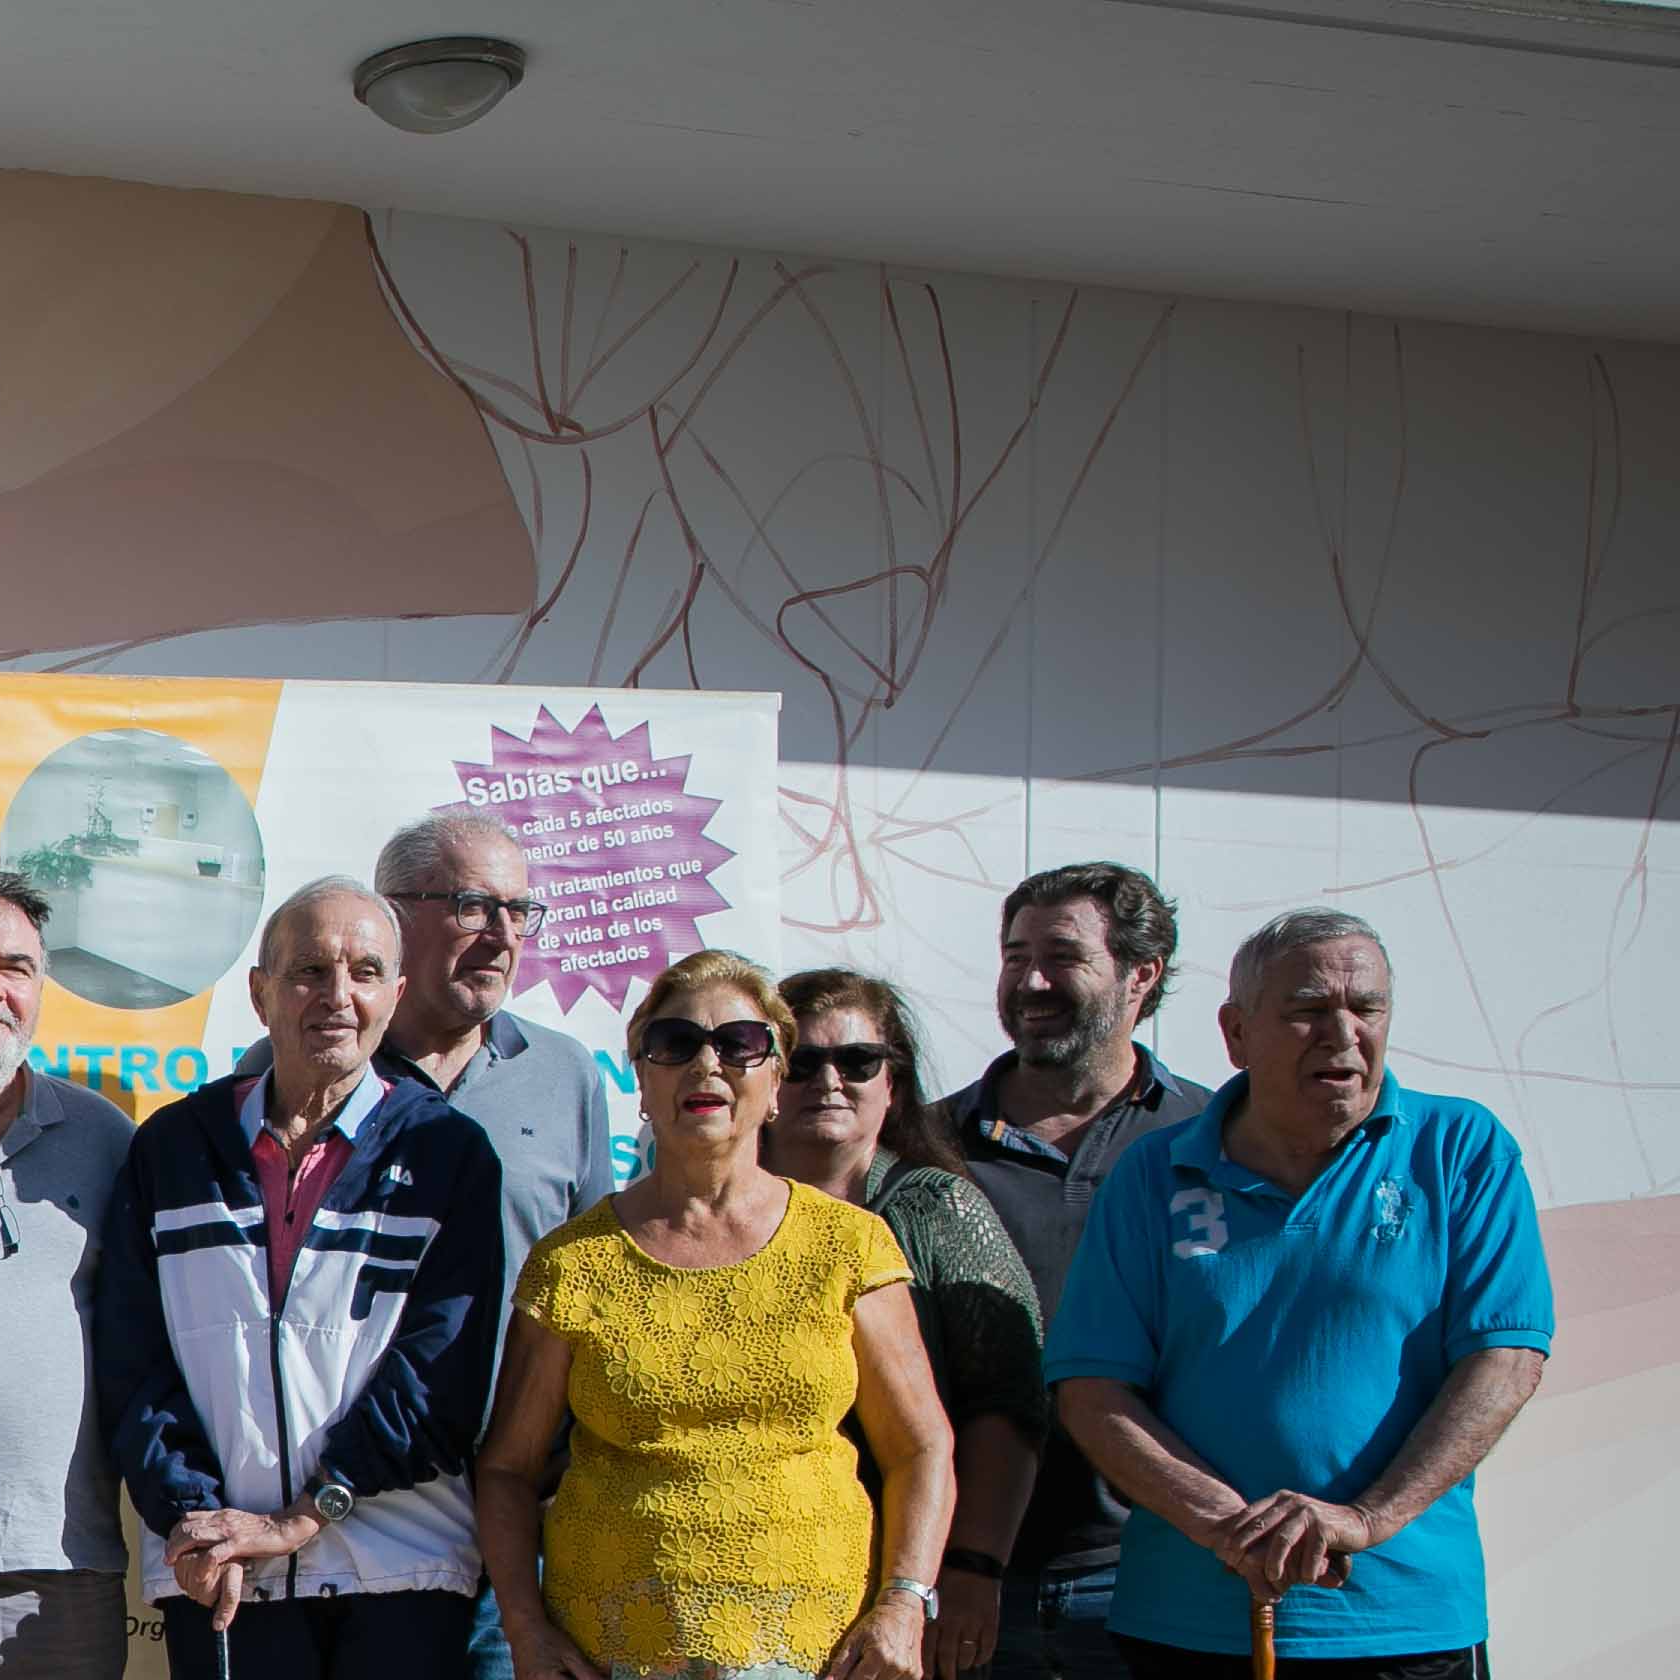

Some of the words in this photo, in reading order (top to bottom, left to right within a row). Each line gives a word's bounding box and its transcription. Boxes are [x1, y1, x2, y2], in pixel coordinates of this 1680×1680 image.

[466, 768, 573, 807] Sabías
[581, 758, 667, 794] que...
[522, 818, 566, 838] cada
[570, 811, 582, 829] 5
[585, 799, 673, 826] afectados
[576, 833, 599, 853] de
[603, 828, 626, 848] 50
[630, 822, 674, 844] años
[549, 864, 664, 899] tratamientos
[668, 859, 702, 882] que
[590, 898, 609, 917] la
[611, 885, 678, 912] calidad
[537, 931, 561, 950] de
[564, 925, 604, 948] vida
[607, 919, 631, 940] de
[634, 914, 664, 935] los
[559, 942, 650, 974] afectados
[1169, 1186, 1229, 1259] 3
